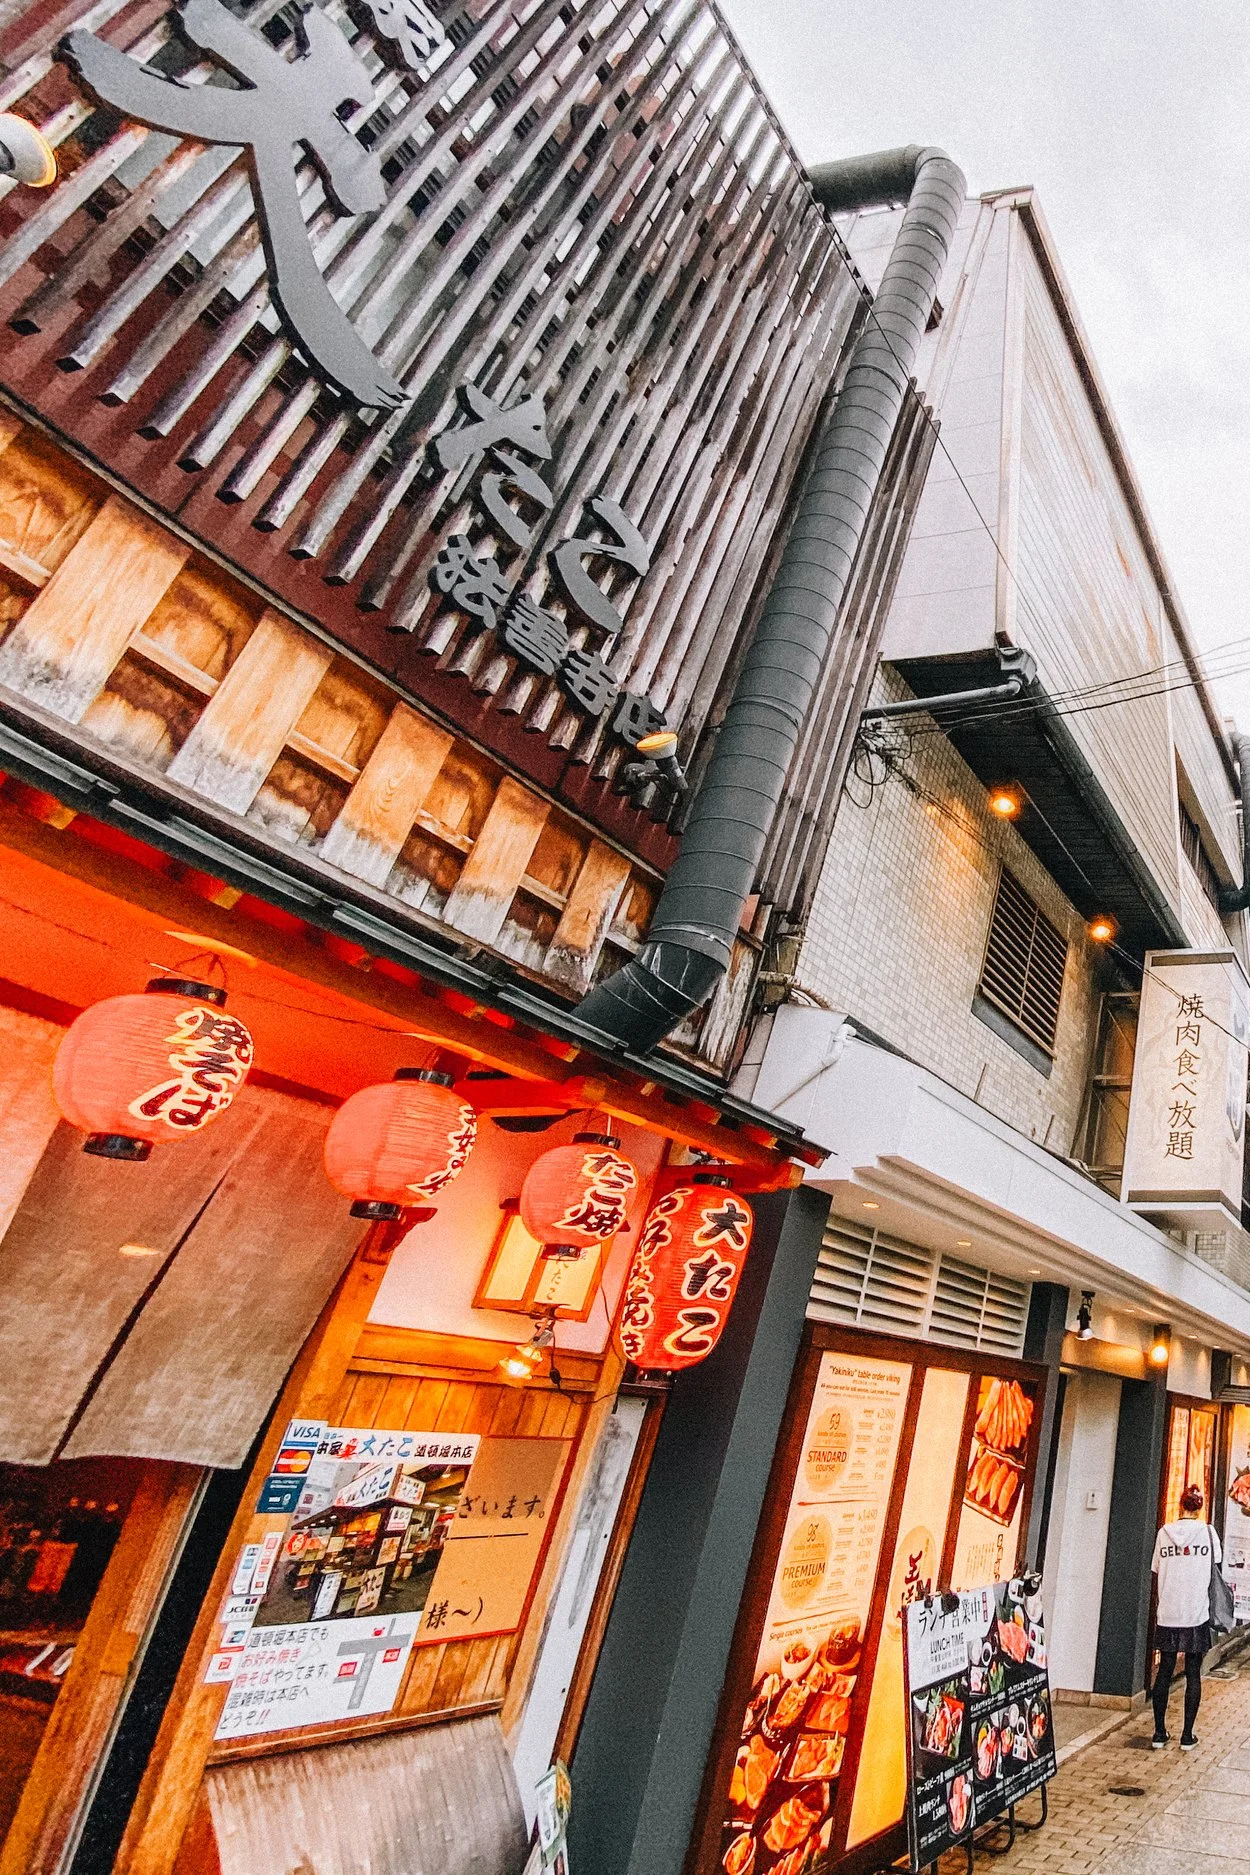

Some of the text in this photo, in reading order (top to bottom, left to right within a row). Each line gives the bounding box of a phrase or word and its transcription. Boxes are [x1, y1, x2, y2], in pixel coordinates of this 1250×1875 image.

[131, 1008, 254, 1131] 焼そば
[1163, 993, 1205, 1161] 焼肉食べ放題
[554, 1153, 636, 1238] たこ焼
[666, 1199, 748, 1355] 大たこ
[292, 1426, 321, 1439] VISA
[359, 1435, 413, 1457] 大たこ
[414, 1444, 474, 1458] 道頓堀本店
[807, 1450, 847, 1463] STANDARD
[815, 1464, 836, 1472] course
[782, 1562, 826, 1580] PREMIUM
[248, 1627, 329, 1649] 道頓堀本店でも
[931, 1637, 950, 1654] LUNCH
[951, 1632, 964, 1646] TIME
[241, 1649, 301, 1668] お好み焼き
